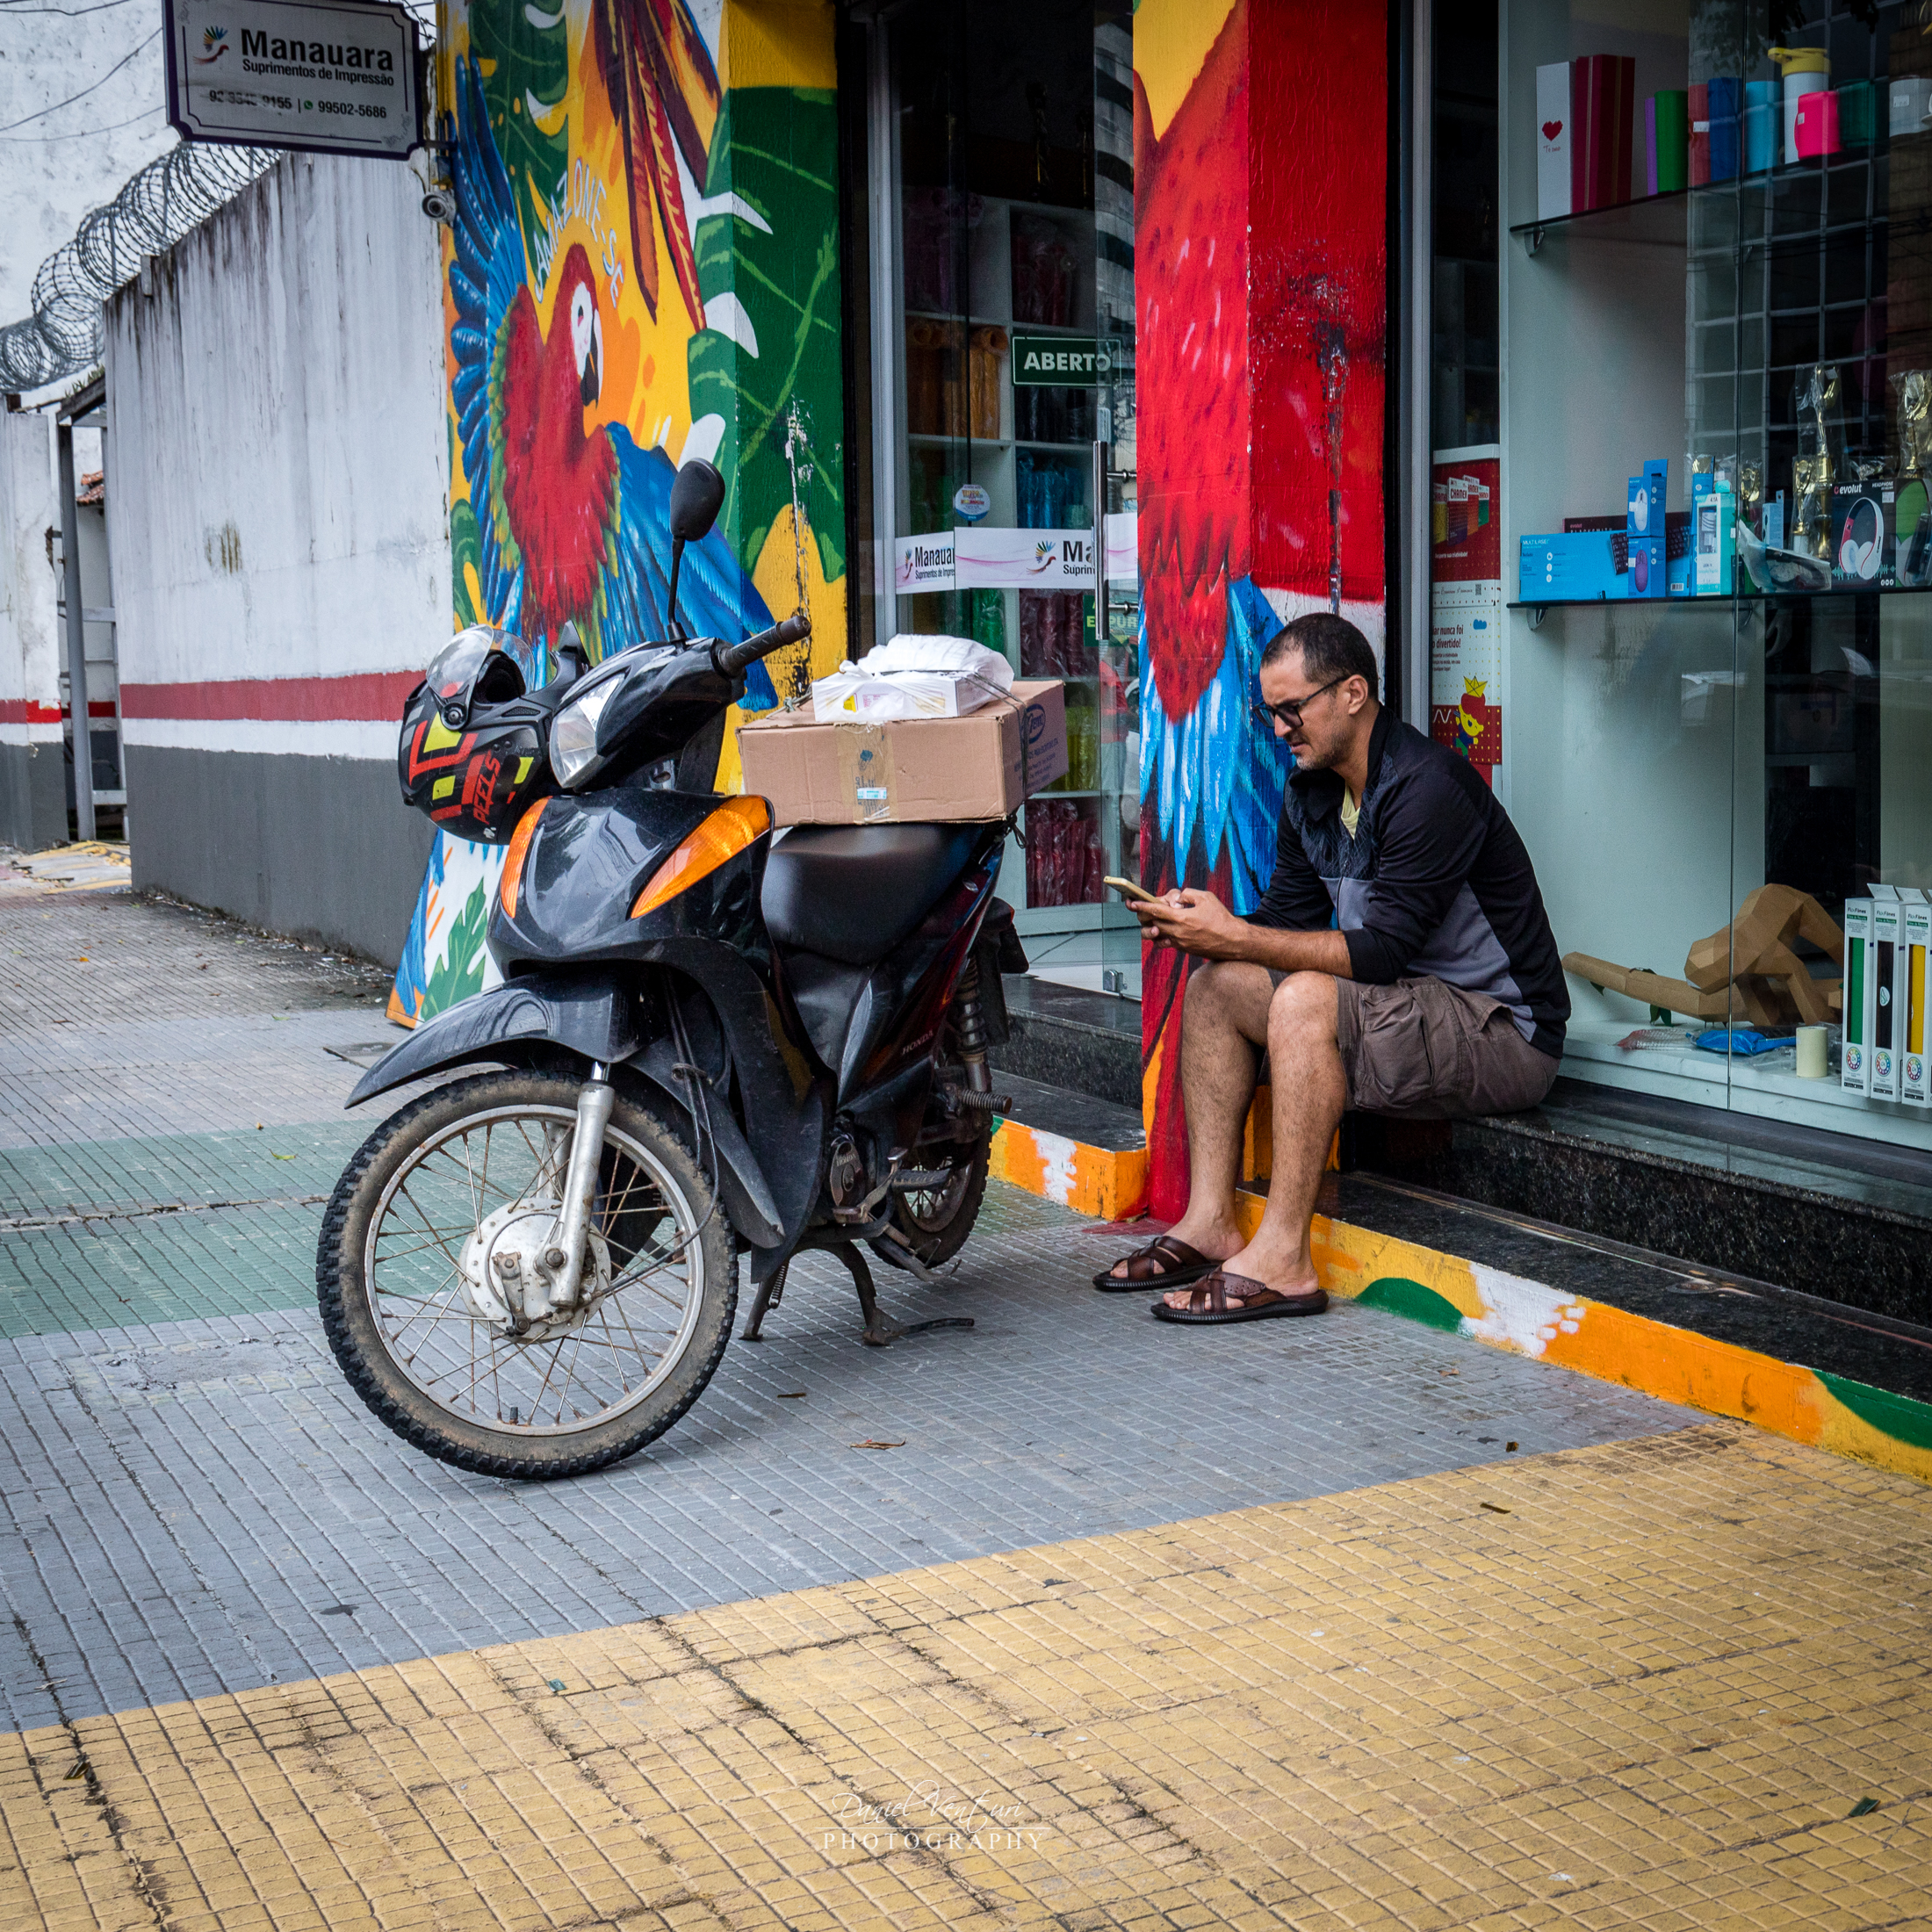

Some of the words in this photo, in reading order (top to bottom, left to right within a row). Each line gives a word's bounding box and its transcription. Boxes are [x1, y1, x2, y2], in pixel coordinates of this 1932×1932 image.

[241, 28, 393, 71] Manauara
[242, 59, 316, 78] Suprimentos
[319, 67, 332, 80] de
[335, 68, 394, 86] Impressão
[318, 101, 386, 119] 99502-5686
[1024, 351, 1111, 371] ABERTO
[1839, 484, 1863, 494] evolut
[1436, 638, 1460, 648] divertido!
[903, 1029, 934, 1055] HONDA
